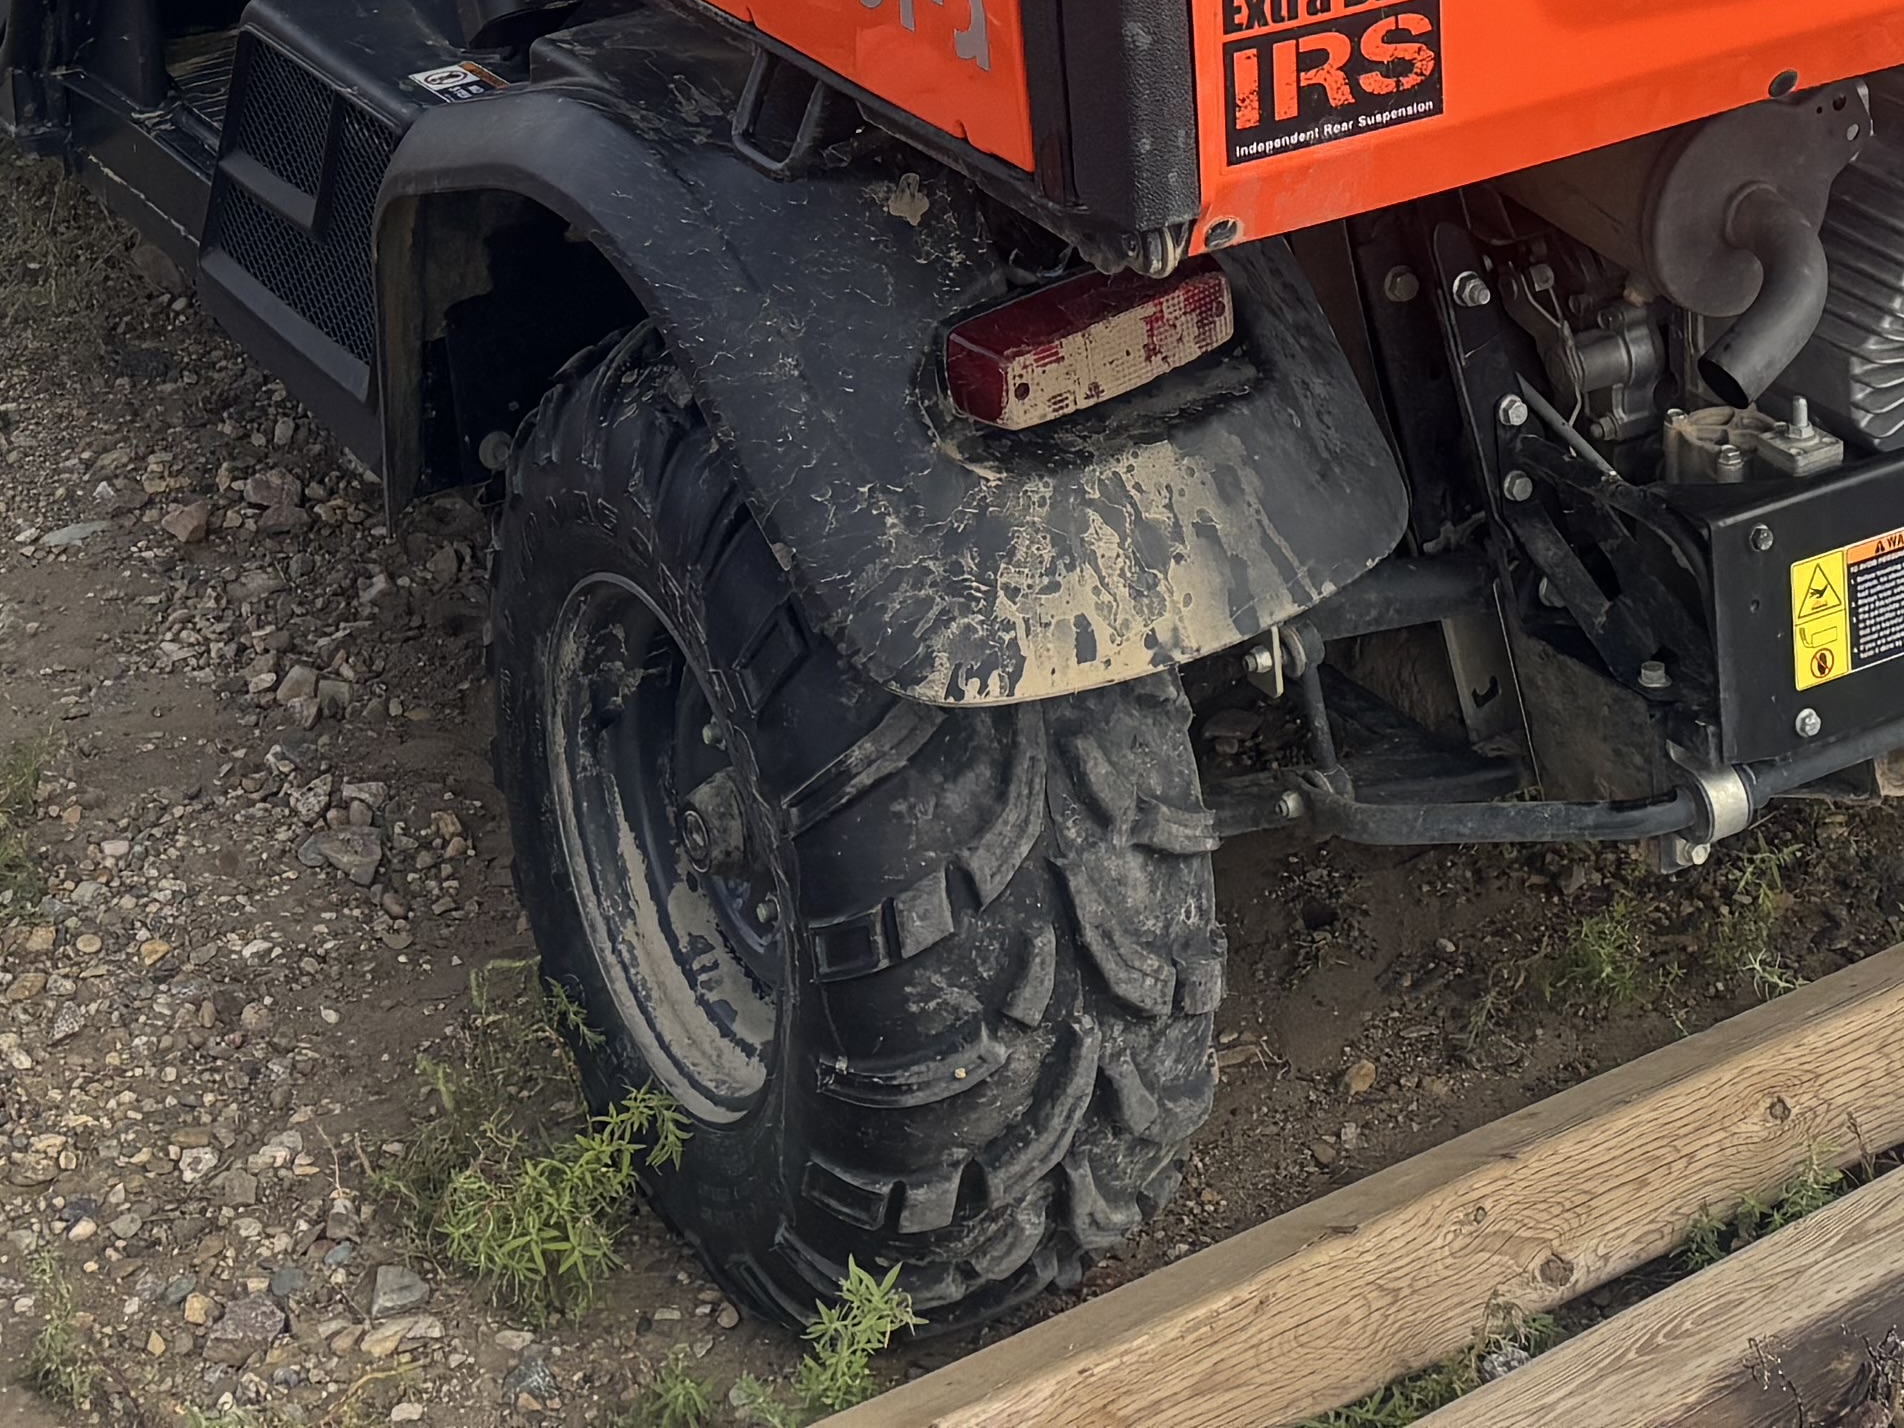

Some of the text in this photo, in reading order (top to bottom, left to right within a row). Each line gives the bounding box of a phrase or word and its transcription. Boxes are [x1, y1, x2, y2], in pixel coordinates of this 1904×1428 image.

[1232, 12, 1436, 130] IRS
[1236, 100, 1434, 157] Independent Rear Suspension
